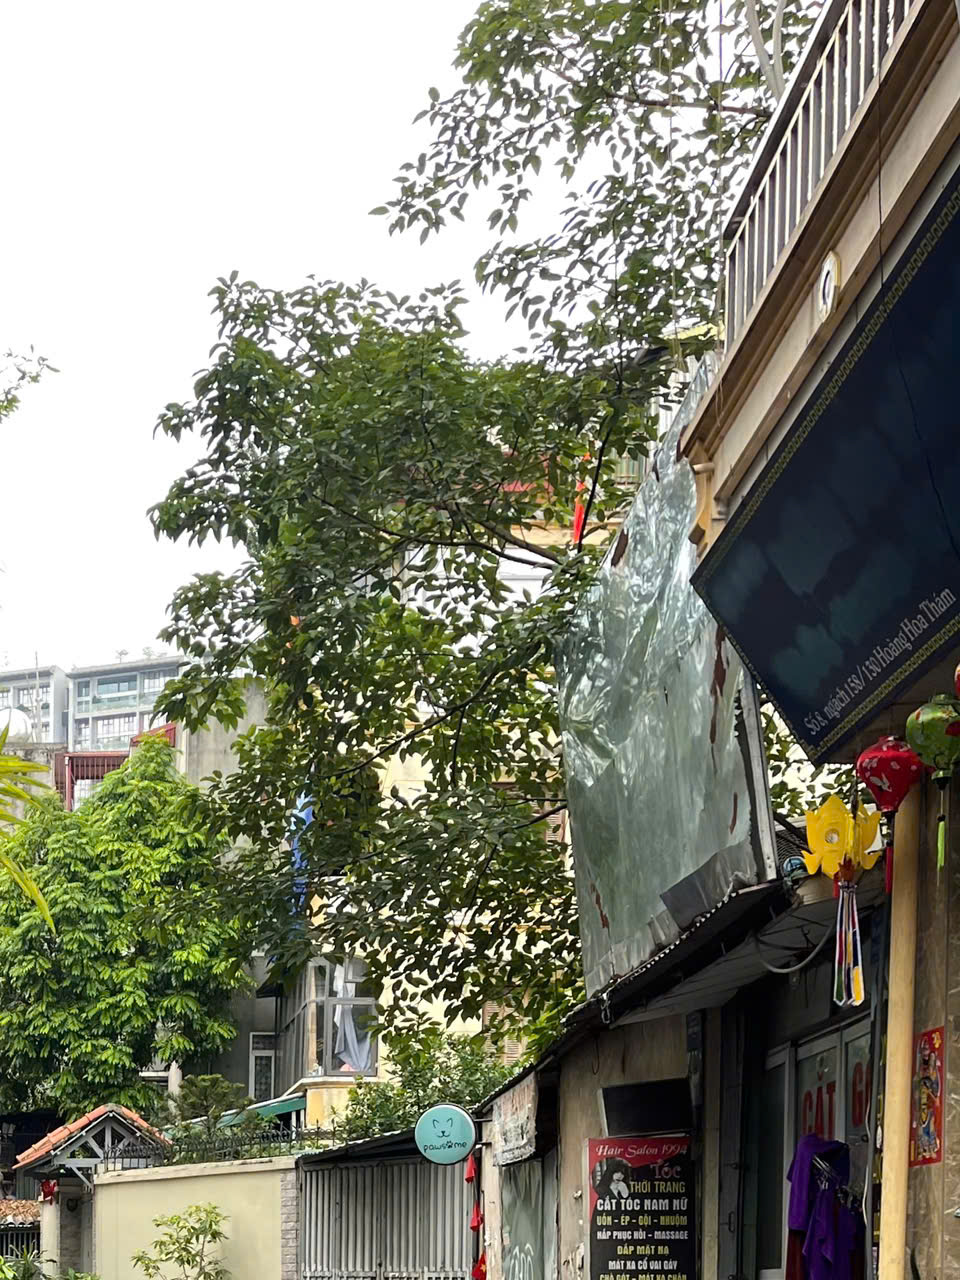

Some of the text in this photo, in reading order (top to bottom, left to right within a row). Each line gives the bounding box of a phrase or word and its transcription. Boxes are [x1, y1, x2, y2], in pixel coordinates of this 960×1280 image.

[804, 712, 819, 735] Số
[824, 686, 850, 718] ngách
[873, 634, 913, 668] Hoàng
[900, 614, 928, 641] Hoa
[919, 588, 957, 623] Thám
[595, 1144, 687, 1158] Hair Salon 1994
[630, 1179, 686, 1193] THỜI TRANG
[596, 1195, 688, 1211] CẮT TÓC NAM NỮ
[596, 1212, 687, 1228] UỐN ÉP GỘI NHUỘM
[597, 1228, 688, 1241] HẤP PHỤC HỒI MASSAGE
[636, 1244, 655, 1256] MẶT
[657, 1245, 669, 1256] NẠ
[608, 1259, 625, 1270] MÁT
[626, 1260, 636, 1270] XA
[649, 1260, 661, 1270] VAI
[663, 1258, 678, 1270] GÁY
